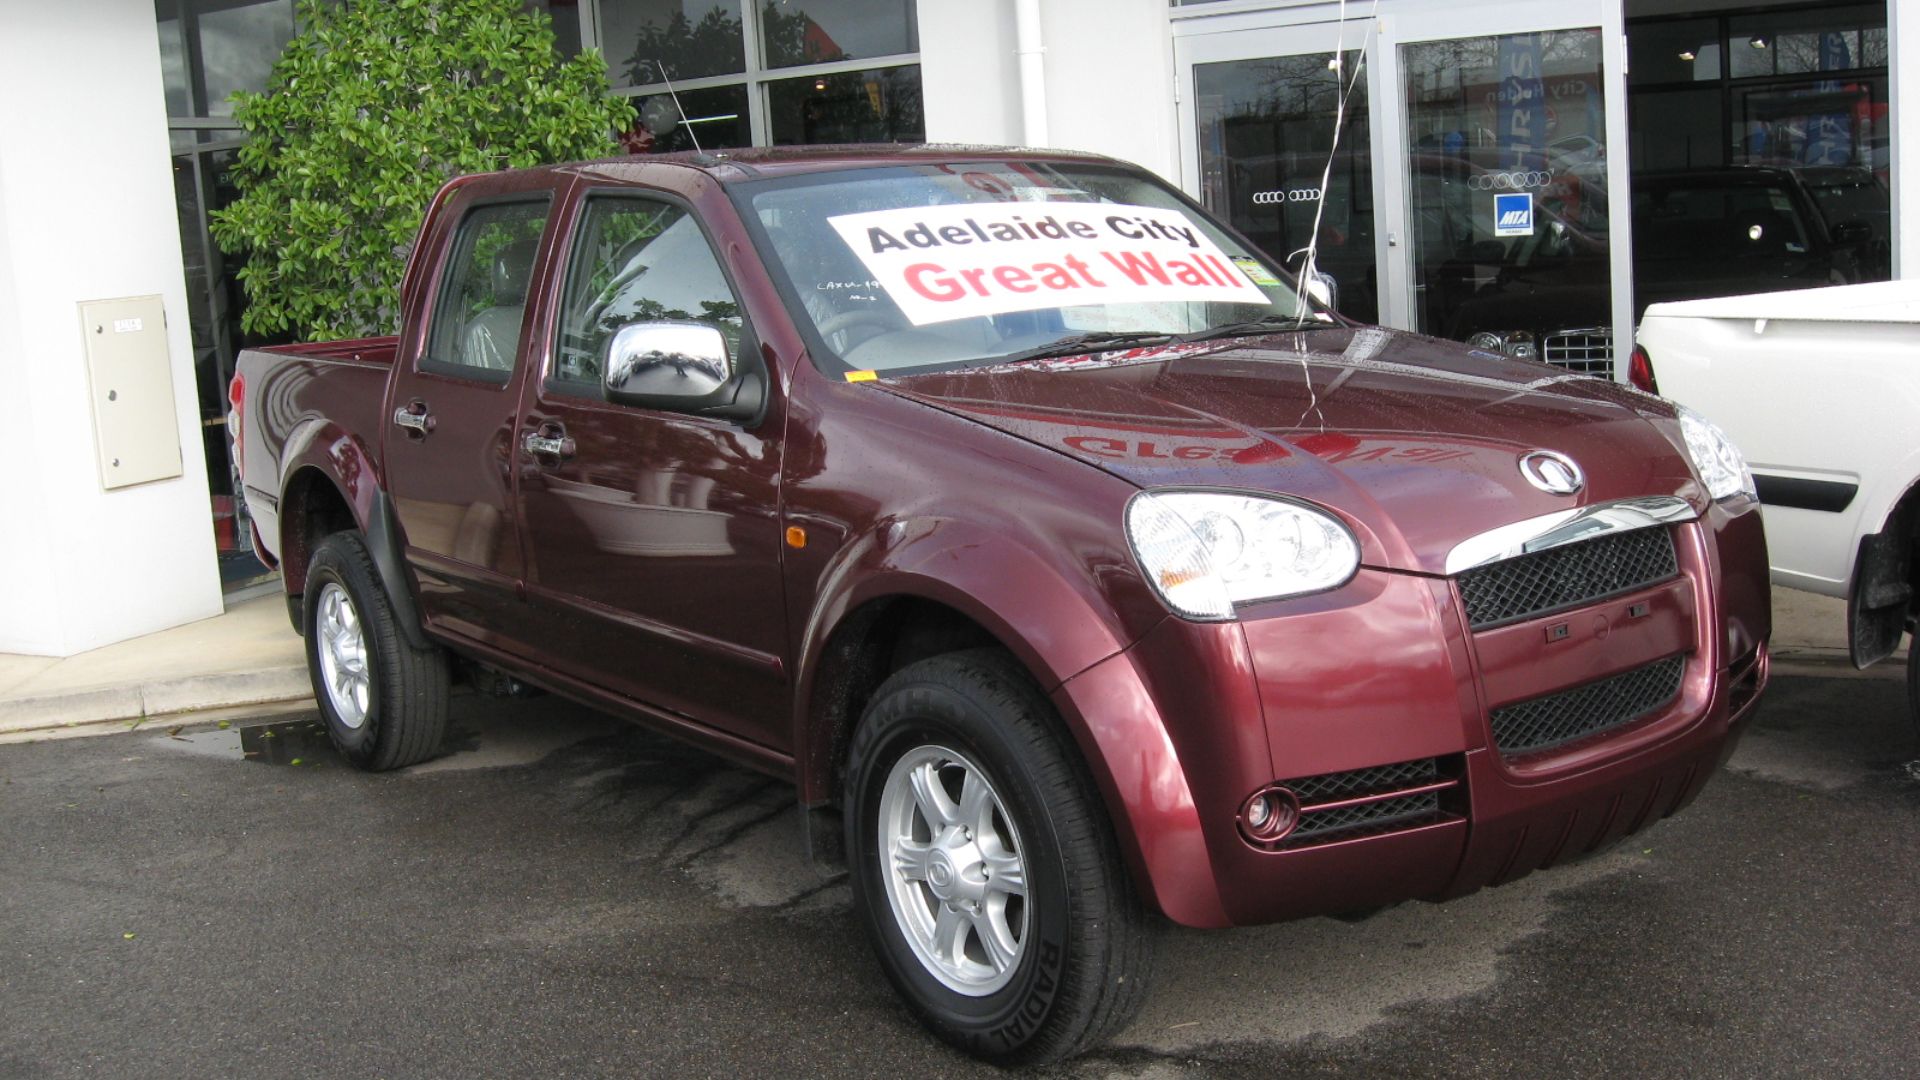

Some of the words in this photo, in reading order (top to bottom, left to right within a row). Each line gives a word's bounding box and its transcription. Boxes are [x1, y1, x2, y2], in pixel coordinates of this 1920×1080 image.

[866, 215, 1099, 254] Adelaide
[1105, 214, 1202, 249] City
[1499, 210, 1529, 225] MTA
[903, 251, 1102, 302] Great
[1102, 250, 1243, 288] Wall
[989, 938, 1060, 1048] RADIAL
